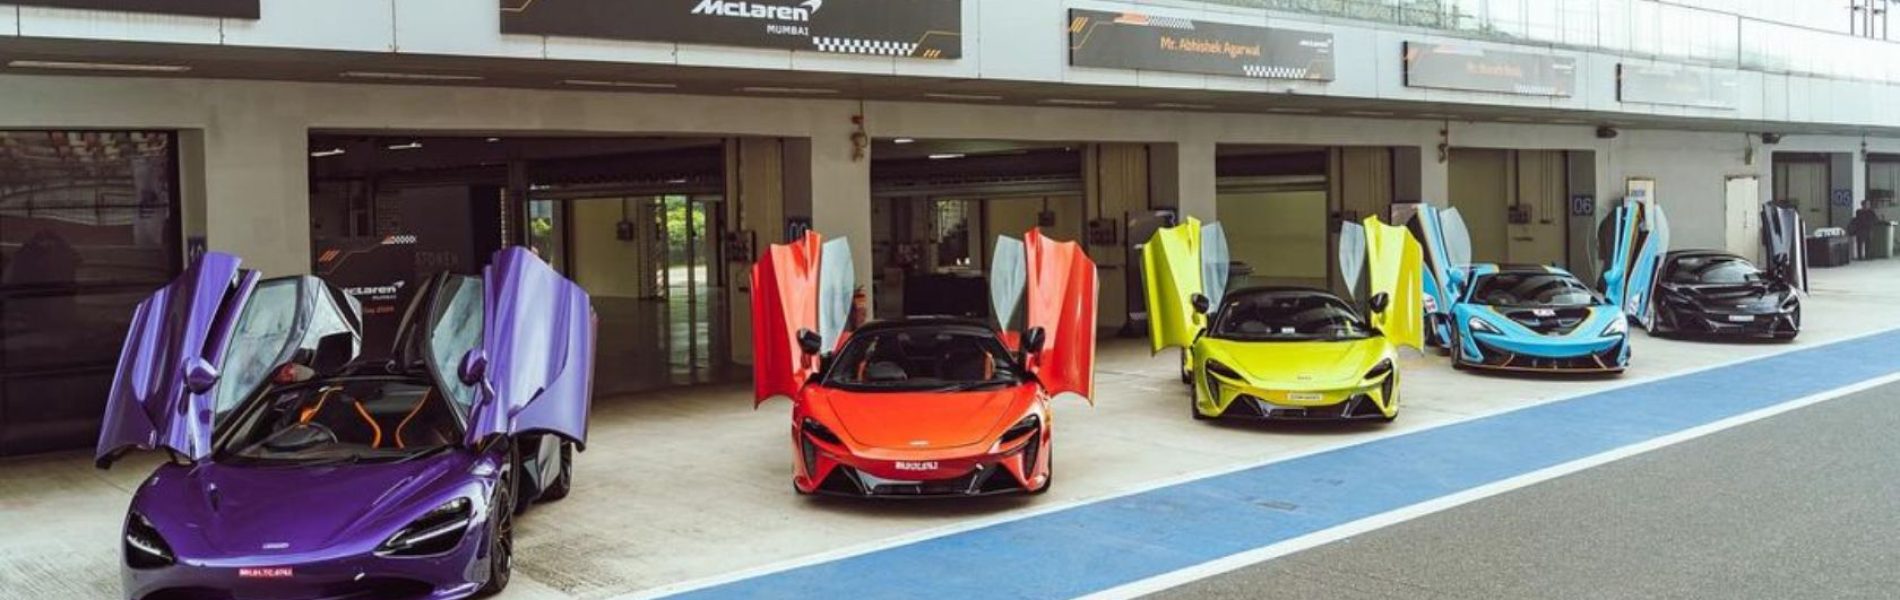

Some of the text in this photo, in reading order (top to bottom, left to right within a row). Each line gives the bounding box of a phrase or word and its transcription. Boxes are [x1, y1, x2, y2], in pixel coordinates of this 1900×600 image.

[690, 0, 809, 21] McLaren
[766, 24, 809, 36] MUMBAI
[1573, 197, 1592, 213] 06
